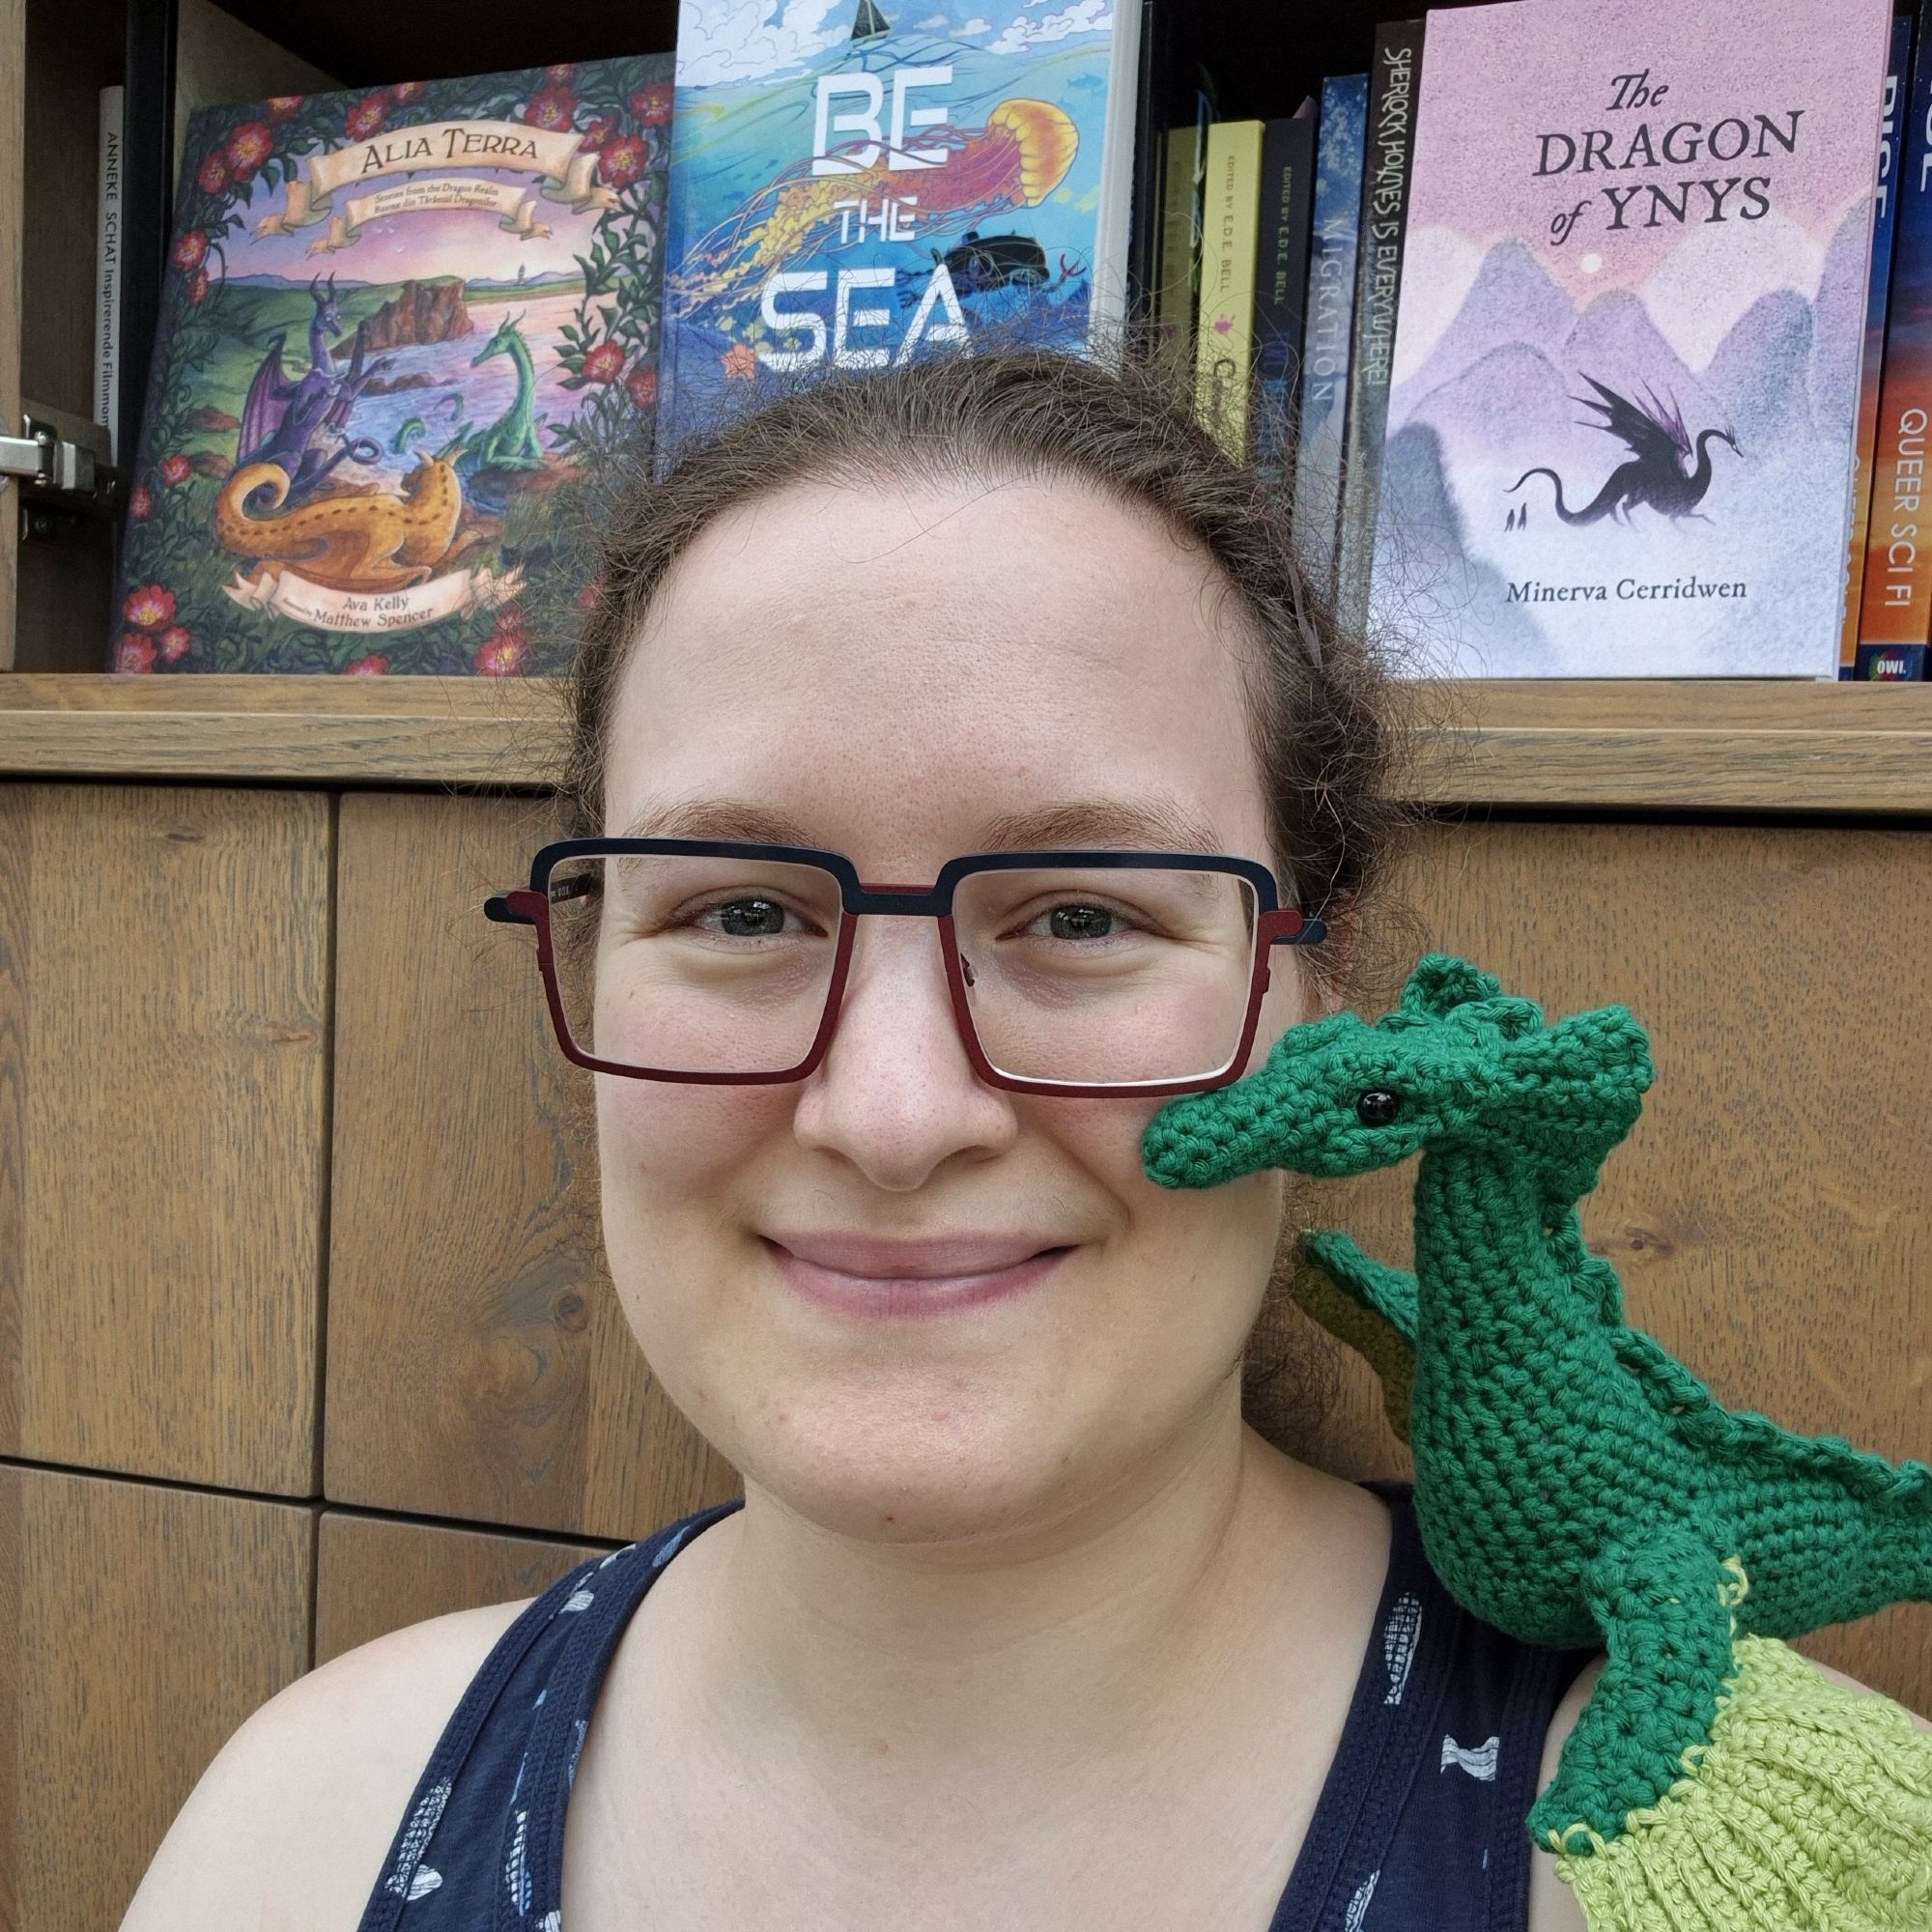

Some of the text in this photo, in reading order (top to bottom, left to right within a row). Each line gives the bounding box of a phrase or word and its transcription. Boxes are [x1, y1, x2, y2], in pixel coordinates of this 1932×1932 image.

[1378, 47, 1411, 138] SHERLOCK
[1605, 68, 1669, 111] The
[812, 66, 952, 176] BE
[1532, 110, 1804, 177] DRAGON
[105, 131, 119, 201] ANNEKE
[361, 128, 537, 174] ALIA TERRA
[1225, 156, 1236, 191] EDITED
[441, 183, 472, 194] Dragon
[1282, 166, 1293, 204] EDITED
[1373, 140, 1406, 215] HOLMES
[834, 196, 917, 244] THE
[1224, 195, 1235, 210] BY
[1549, 177, 1771, 246] of YNYS
[104, 212, 117, 263] SCHAT
[1372, 221, 1400, 240] IS
[1220, 259, 1233, 294] BELL
[1274, 271, 1287, 305] BELL
[102, 270, 115, 358] Inspirerende
[758, 263, 976, 372] SEA
[1312, 218, 1344, 401] MIGRATION
[1885, 408, 1927, 606] QUEER SCI FI
[343, 596, 409, 611] Ava Kelly
[1505, 576, 1747, 603] Minerva Cerridwen
[313, 608, 433, 627] Matthew Spencer
